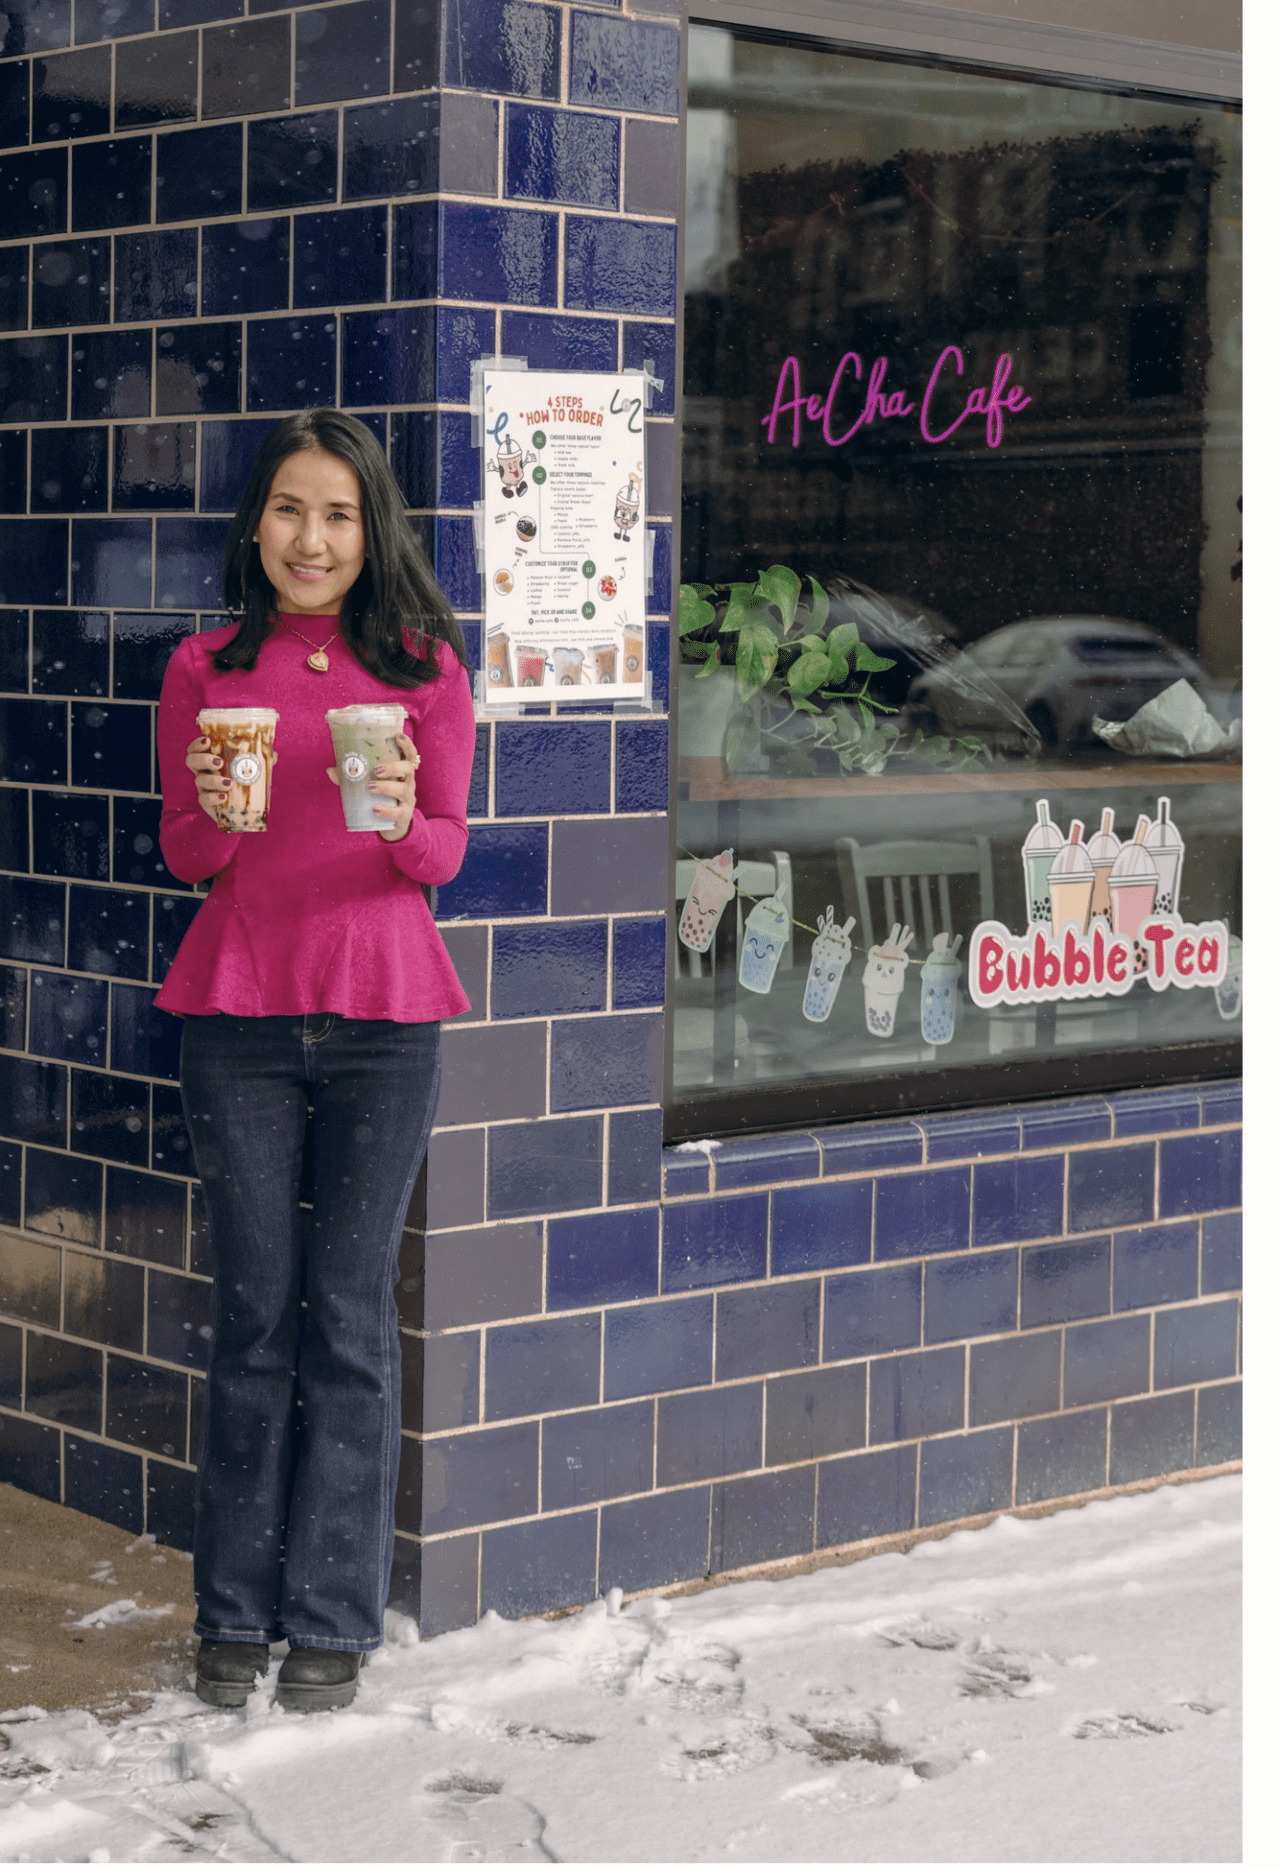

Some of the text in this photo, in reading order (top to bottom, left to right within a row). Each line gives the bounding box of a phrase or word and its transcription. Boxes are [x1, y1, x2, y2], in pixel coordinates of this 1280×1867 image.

[526, 408, 604, 427] HOW TO ORDER
[547, 396, 583, 409] 4 STEPS
[761, 345, 1033, 448] AeCha Cafe
[978, 923, 1219, 995] Bubble Tea
